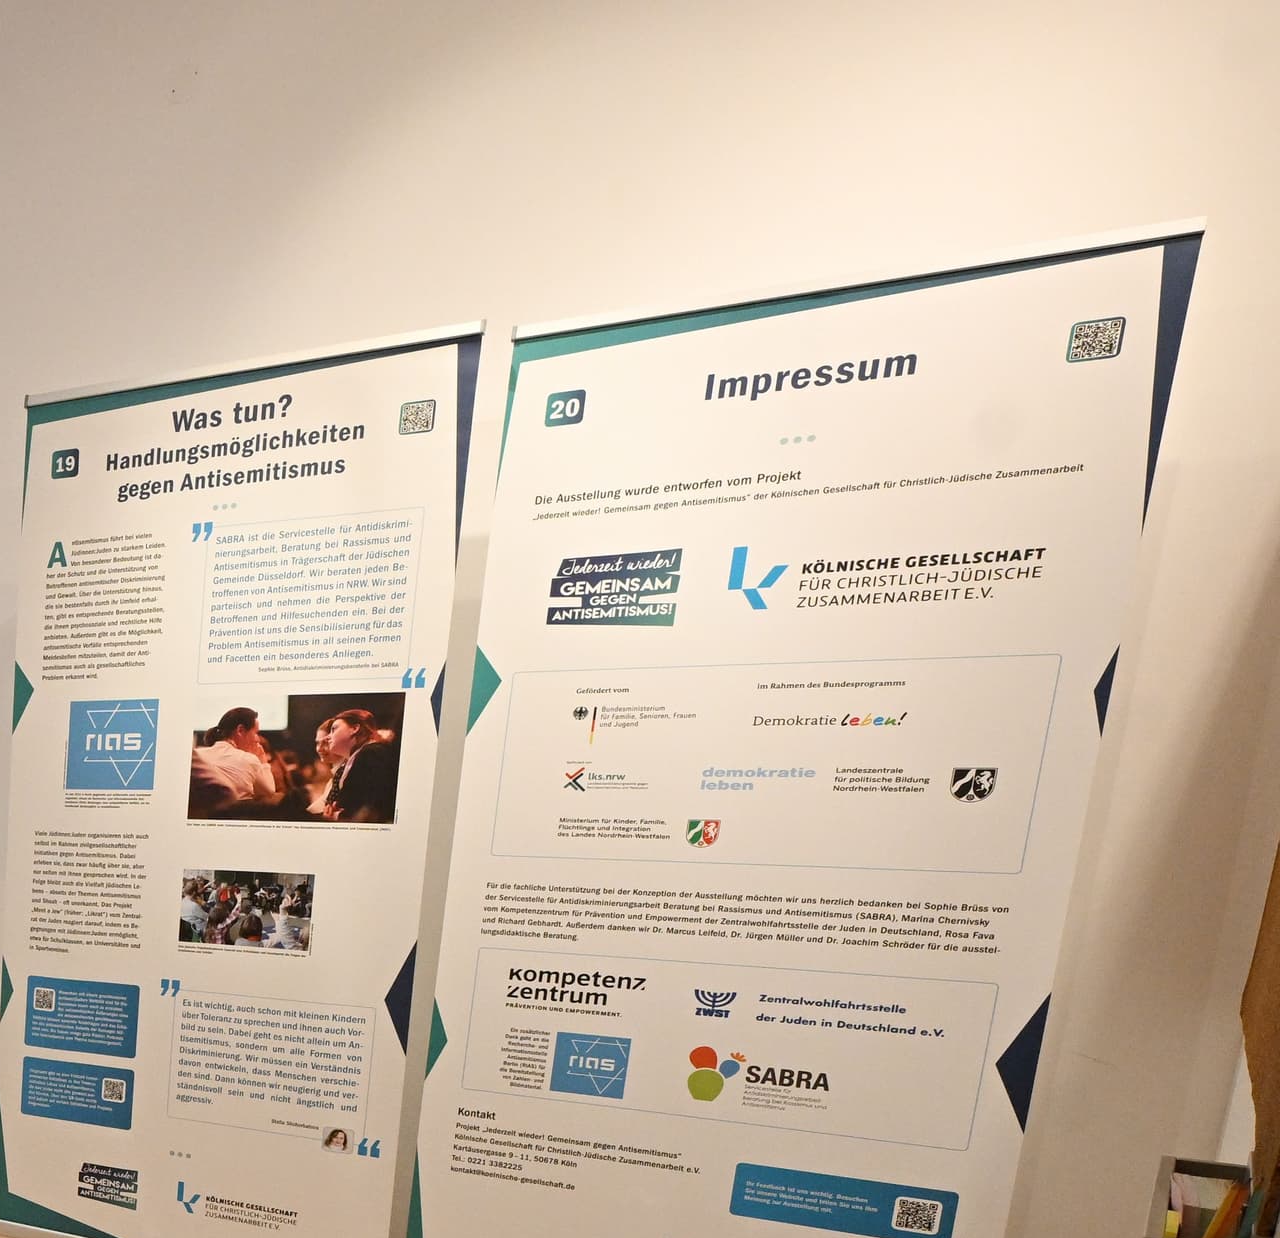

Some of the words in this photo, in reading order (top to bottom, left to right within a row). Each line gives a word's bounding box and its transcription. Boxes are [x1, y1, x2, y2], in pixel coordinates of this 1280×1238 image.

[704, 353, 917, 401] Impressum
[171, 407, 222, 433] Was
[232, 393, 293, 424] tun?
[550, 397, 581, 421] 20
[105, 424, 365, 472] Handlungsmöglichkeiten
[55, 456, 76, 474] 19
[116, 479, 174, 503] gegen
[179, 459, 345, 492] Antisemitismus
[534, 495, 553, 505] Die
[555, 488, 621, 503] Ausstellung
[624, 484, 660, 496] wurde
[663, 478, 722, 493] entworfen
[726, 476, 752, 487] vom
[756, 470, 802, 485] Projekt
[215, 534, 245, 545] SABRA
[247, 533, 259, 543] ist
[261, 531, 275, 541] die
[278, 526, 335, 539] Servicestelle
[339, 524, 352, 534] für
[354, 519, 413, 536] Antidiskrimi-
[563, 557, 624, 578] Jederzeit
[626, 554, 676, 571] wieder!
[801, 557, 901, 574] KÖLNISCHE
[905, 547, 1047, 569] GESELLSCHAFT
[559, 576, 672, 597] GEMEINSAM
[799, 576, 831, 591] FÜR
[836, 565, 1043, 589] CHRISTLICH-JÜDISCHE
[589, 593, 637, 606] GEGEN
[796, 588, 961, 608] ZUSAMMENARBEIT
[963, 586, 994, 600] E.V.
[551, 602, 673, 622] ANTISEMITISMUS!
[207, 654, 223, 663] und
[225, 653, 260, 663] Facetten
[263, 652, 276, 661] ein
[278, 650, 330, 661] besonderes
[331, 647, 374, 659] Anliegen.
[822, 680, 906, 689] Bundesprogramms
[587, 772, 626, 784] lks.nrw
[702, 767, 816, 778] demokratie
[834, 775, 847, 786] für
[848, 776, 893, 787] politische
[894, 776, 930, 787] Bildung
[700, 779, 754, 791] leben
[832, 785, 925, 793] Nordrhein-Westfalen
[182, 998, 192, 1007] Es
[192, 999, 203, 1008] ist
[204, 1001, 235, 1013] wichtig,
[235, 1005, 256, 1013] auch
[257, 1007, 282, 1016] schon
[283, 1009, 297, 1018] mit
[298, 1010, 330, 1021] kleinen
[331, 1013, 366, 1024] Kindern
[505, 1002, 548, 1011] PRÄVENTION
[564, 1007, 622, 1017] EMPOWERMENT.
[695, 1007, 730, 1018] ZWST
[758, 994, 906, 1014] Zentralwohlfahrtsstelle
[755, 1012, 776, 1022] der
[779, 1015, 817, 1026] Juden
[820, 1018, 832, 1027] in
[836, 1020, 916, 1035] Deutschland
[919, 1028, 944, 1038] e.V.
[745, 1065, 829, 1089] SABRA
[457, 1107, 496, 1120] Kontakt
[451, 1154, 466, 1162] Tel.:
[467, 1156, 486, 1166] 0221
[488, 1159, 523, 1171] 3382225
